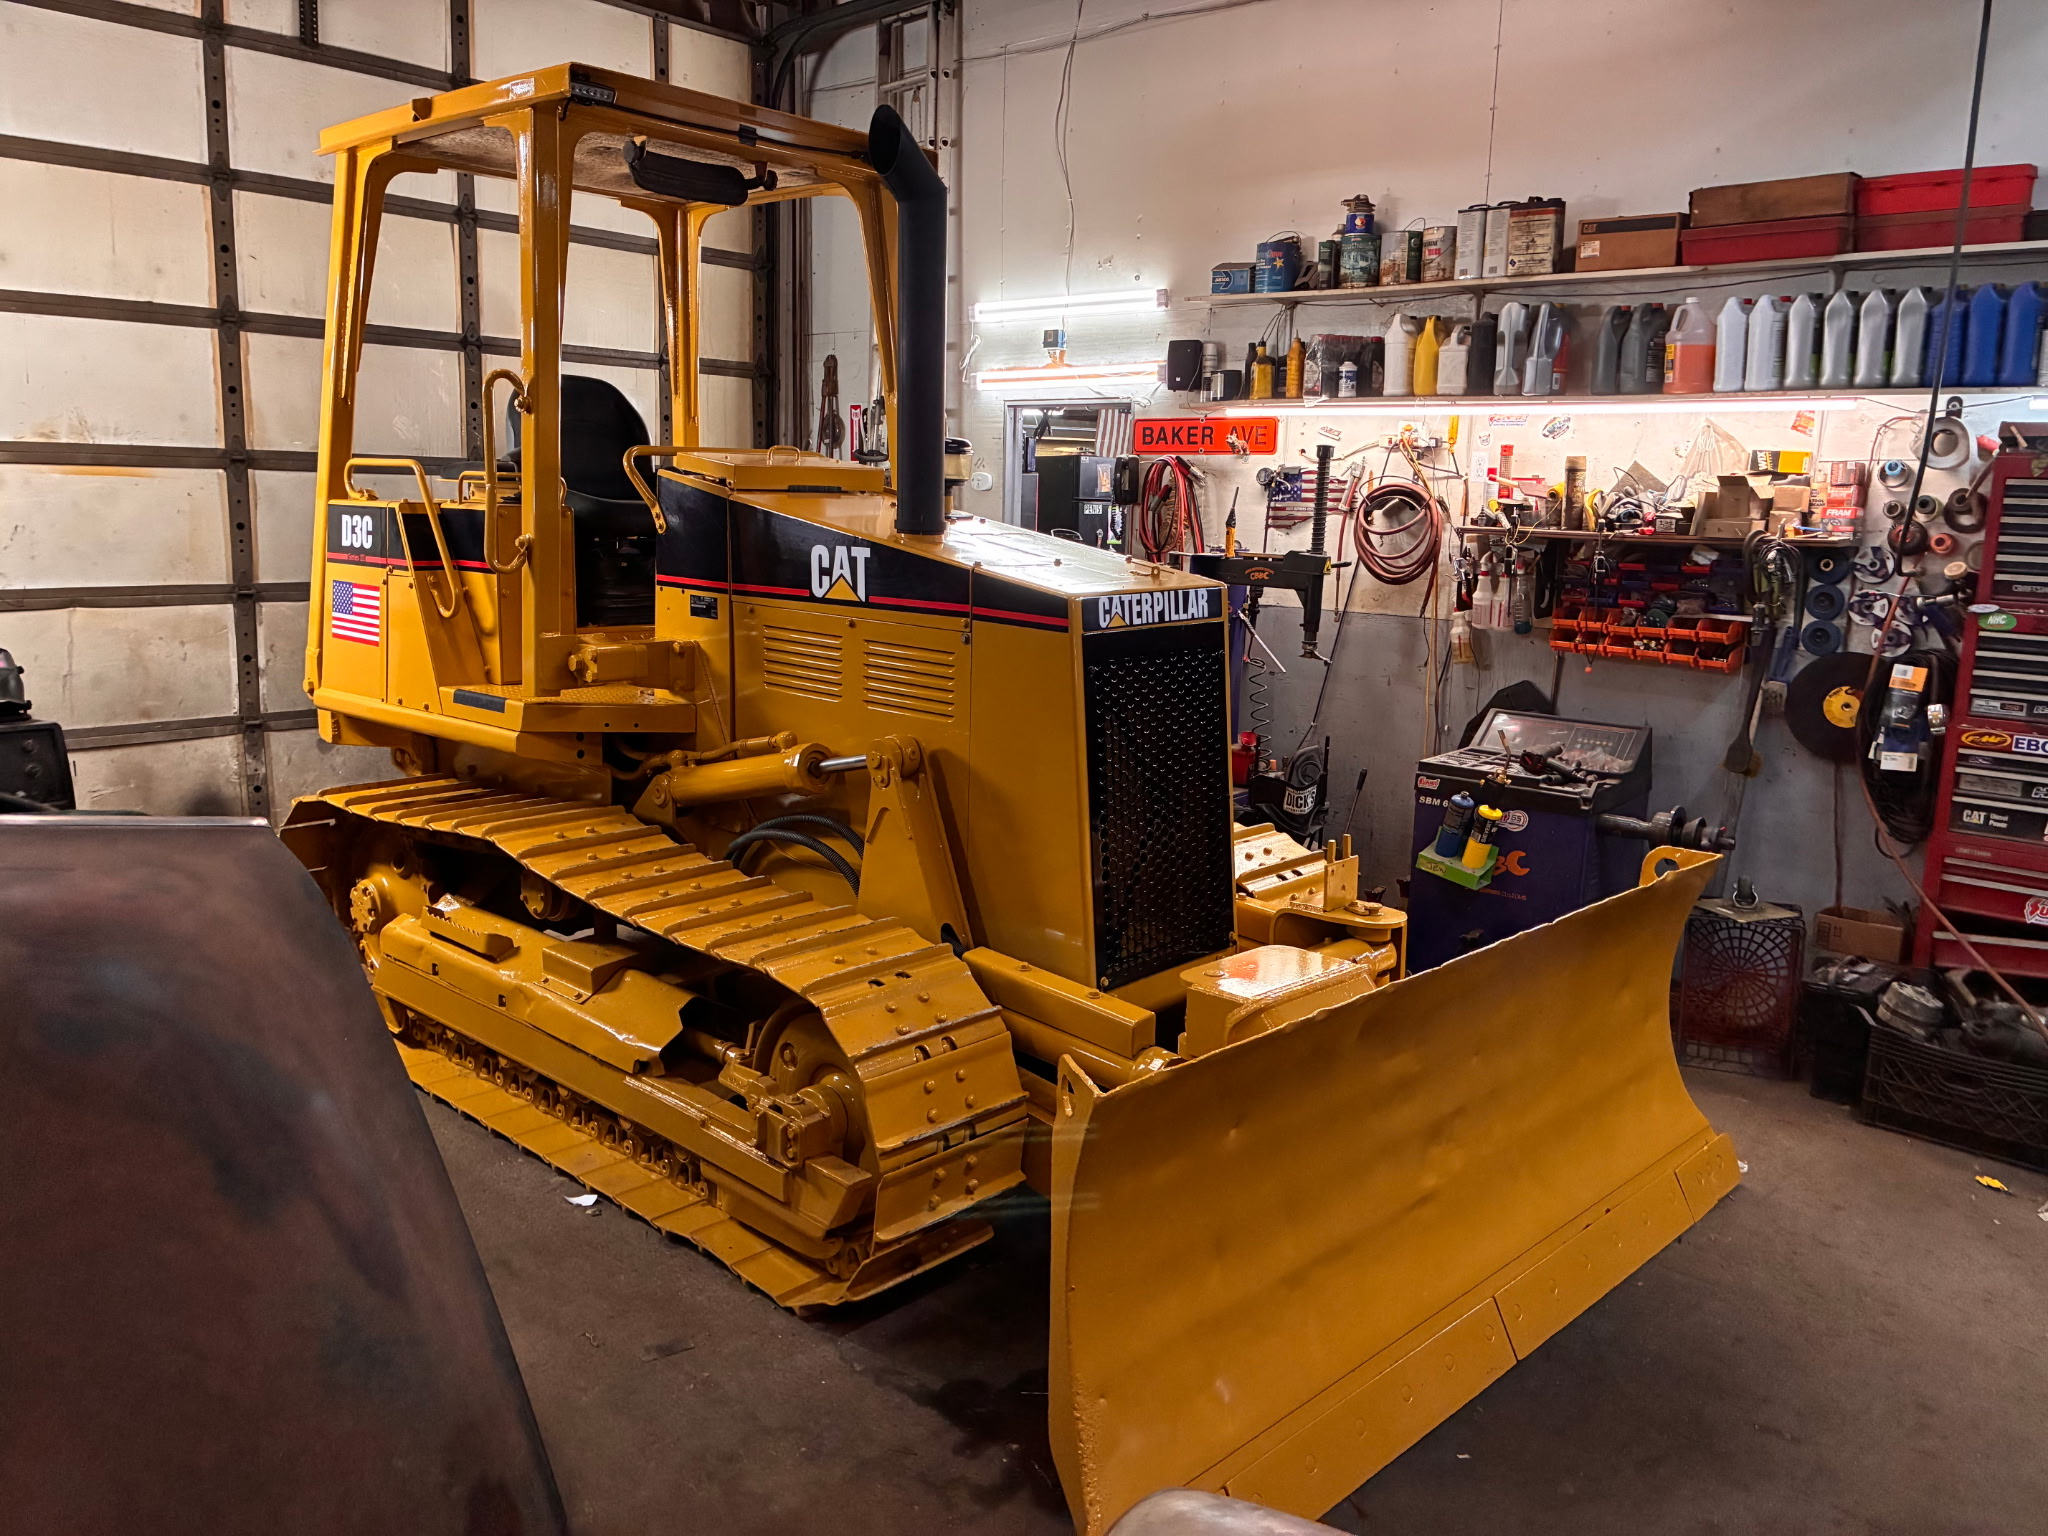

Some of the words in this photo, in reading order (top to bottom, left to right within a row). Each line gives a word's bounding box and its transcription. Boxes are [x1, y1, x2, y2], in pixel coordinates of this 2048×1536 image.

[1142, 426, 1214, 445] BAKER
[1757, 451, 1768, 470] WIX
[1084, 504, 1102, 514] PENIS
[1826, 508, 1852, 516] FRAM
[341, 514, 373, 549] D3C
[811, 544, 871, 602] CAT
[1099, 588, 1208, 628] CATERPILLAR
[1987, 614, 2007, 625] NHC
[1286, 790, 1316, 809] DICK'S
[1419, 796, 1441, 807] SBM
[1962, 809, 1986, 825] CAT
